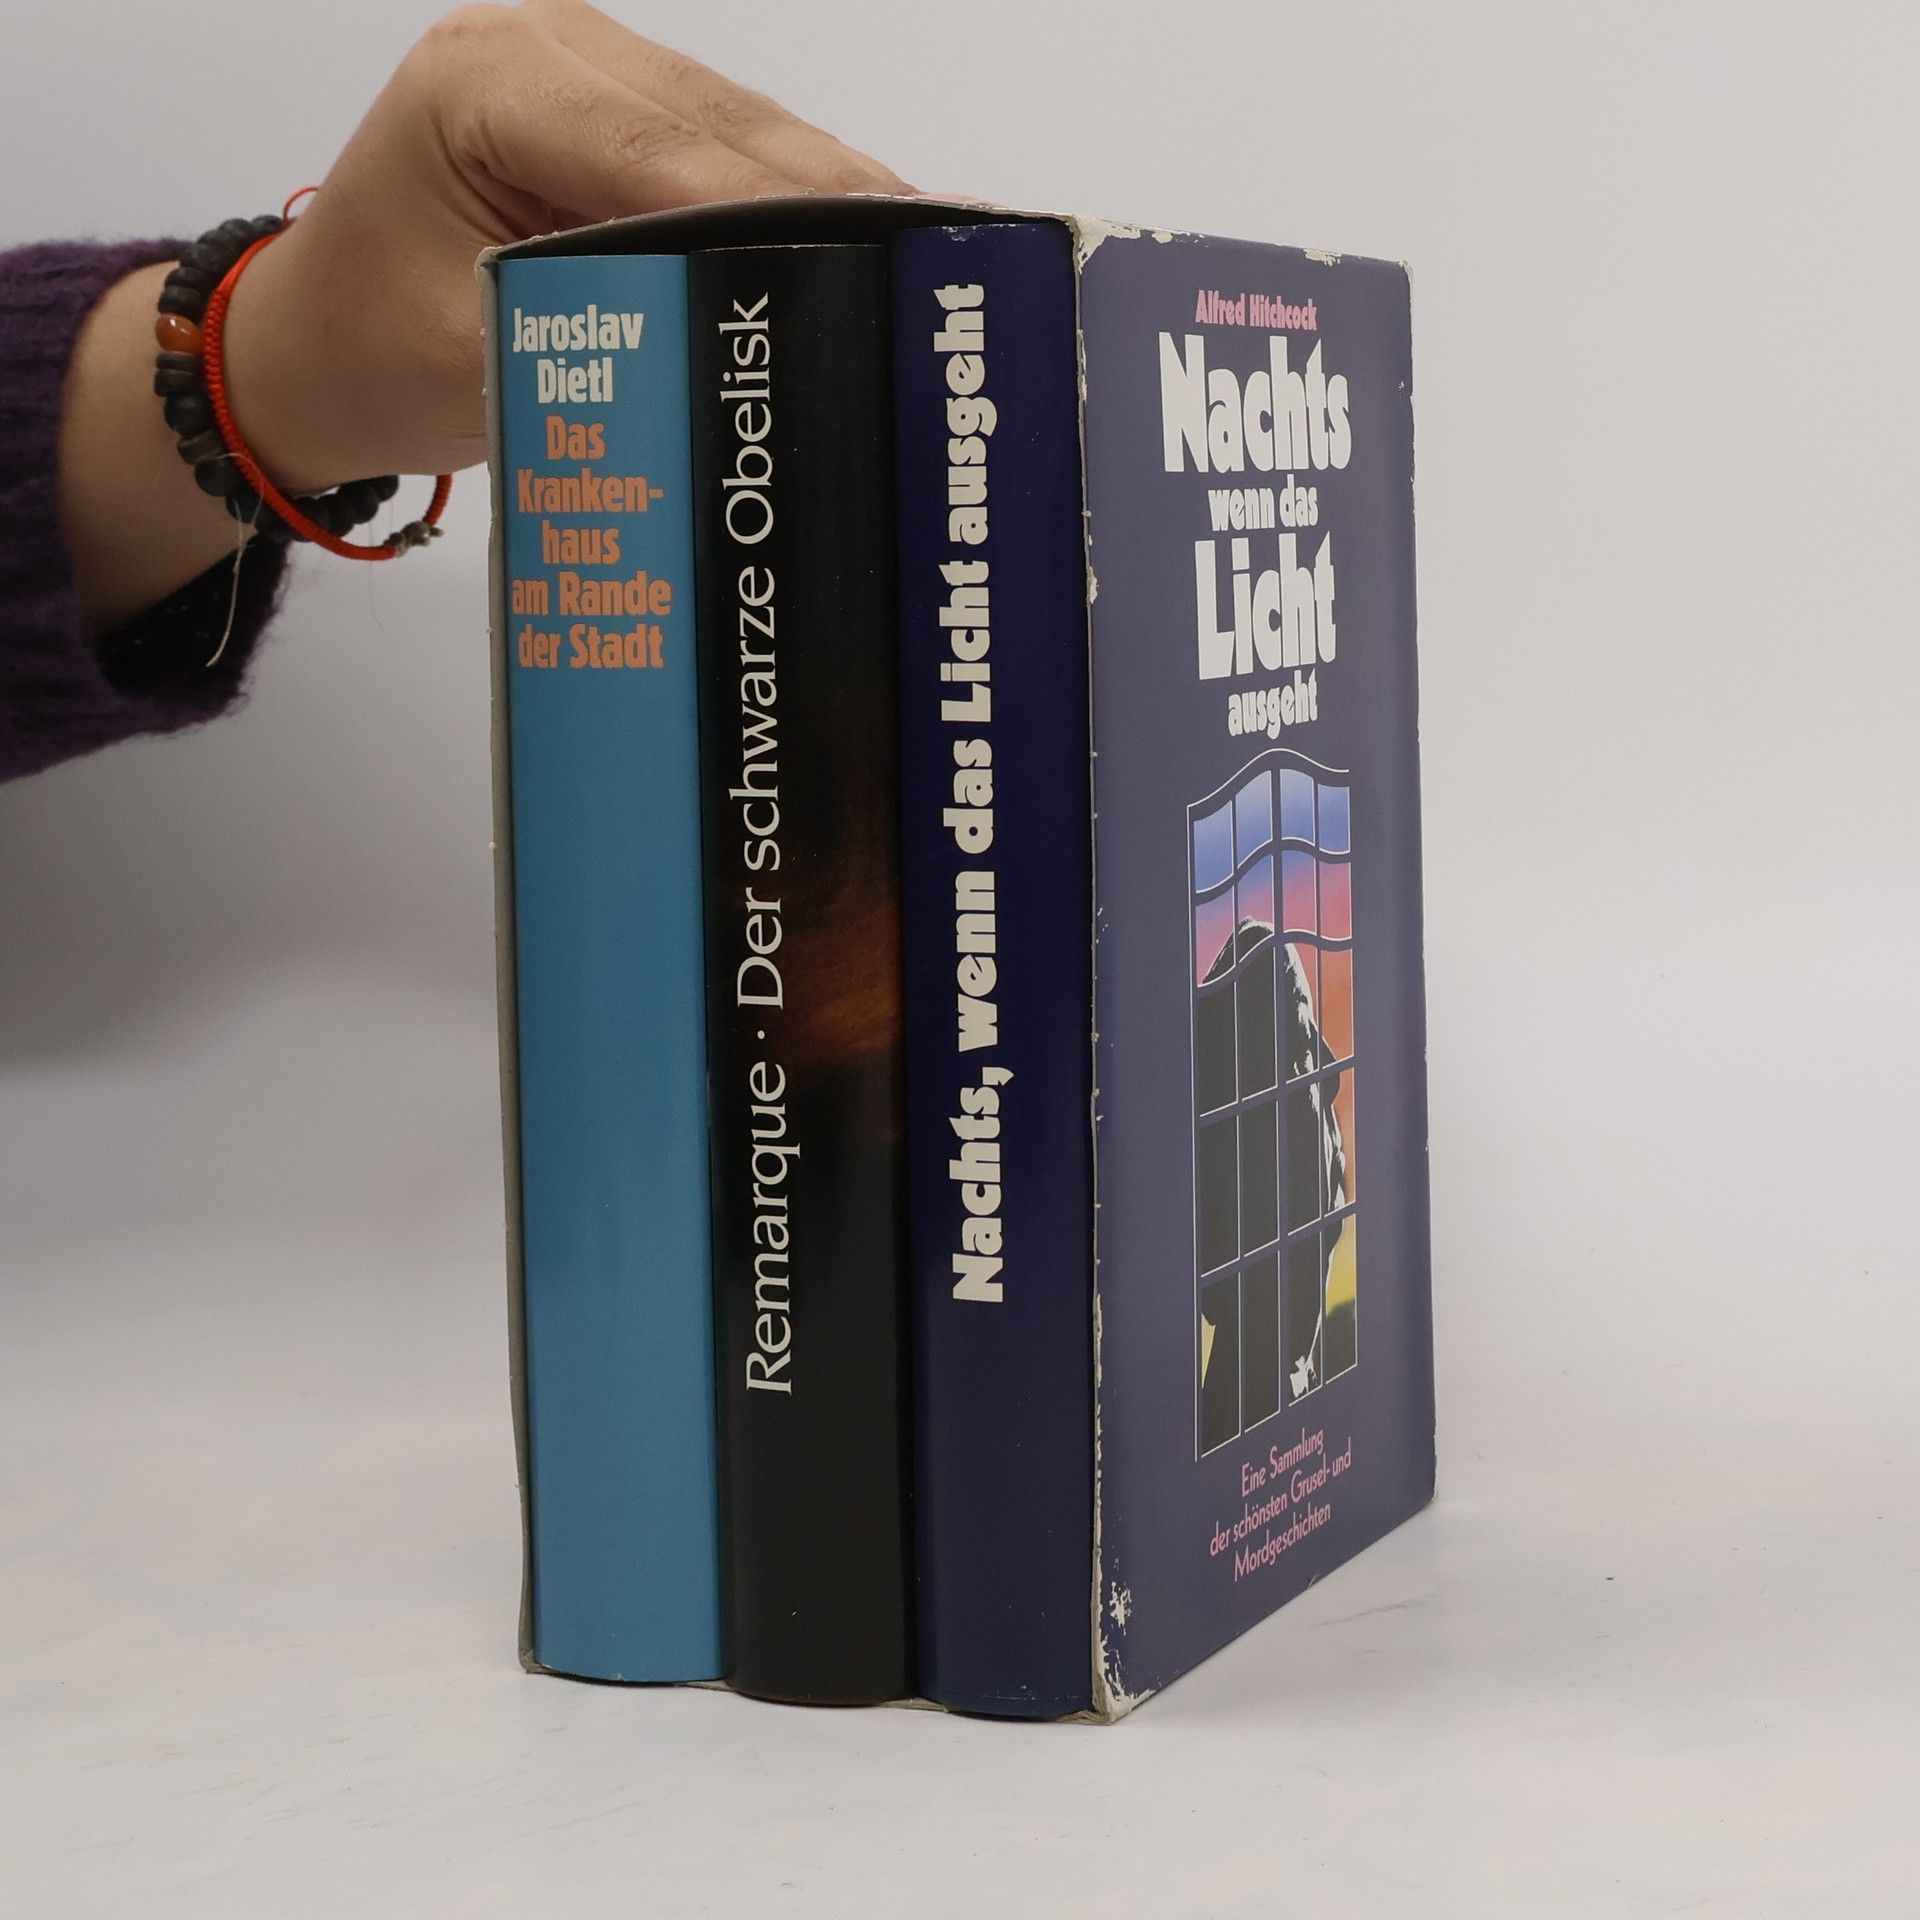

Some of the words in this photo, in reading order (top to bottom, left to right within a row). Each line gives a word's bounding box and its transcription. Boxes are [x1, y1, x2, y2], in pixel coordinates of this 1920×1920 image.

[514, 304, 644, 353] Jaroslav
[1195, 290, 1246, 327] Alfred
[1249, 294, 1318, 331] Hitchcock
[537, 357, 613, 403] Dietl
[718, 292, 775, 545] Obelisk
[933, 284, 998, 545] ausgeht
[1158, 332, 1352, 474] Nachts
[547, 416, 605, 459] Das
[518, 468, 663, 513] Kranken-
[1208, 486, 1275, 532] wenn
[1279, 474, 1319, 530] das
[542, 522, 621, 564] haus
[512, 581, 548, 615] am
[559, 572, 672, 616] Rande
[938, 560, 991, 723] Licht
[1194, 531, 1336, 681] Licht
[518, 624, 560, 668] der
[571, 623, 664, 668] Stadt
[728, 566, 781, 871] schwarze
[1227, 670, 1319, 740] ausgeht
[943, 738, 994, 854] das
[737, 887, 783, 1009] Der
[955, 871, 998, 1053] wenn
[746, 1061, 801, 1394] Remarque
[949, 1066, 1014, 1303] Nachts,
[1209, 1521, 1231, 1557] der
[1234, 1493, 1288, 1543] schönsten
[1290, 1453, 1331, 1504] Grusel-
[1332, 1437, 1353, 1476] und
[1241, 1463, 1266, 1497] Eine
[1269, 1427, 1324, 1479] Sammlung
[1234, 1502, 1331, 1582] Mordgeschichten
